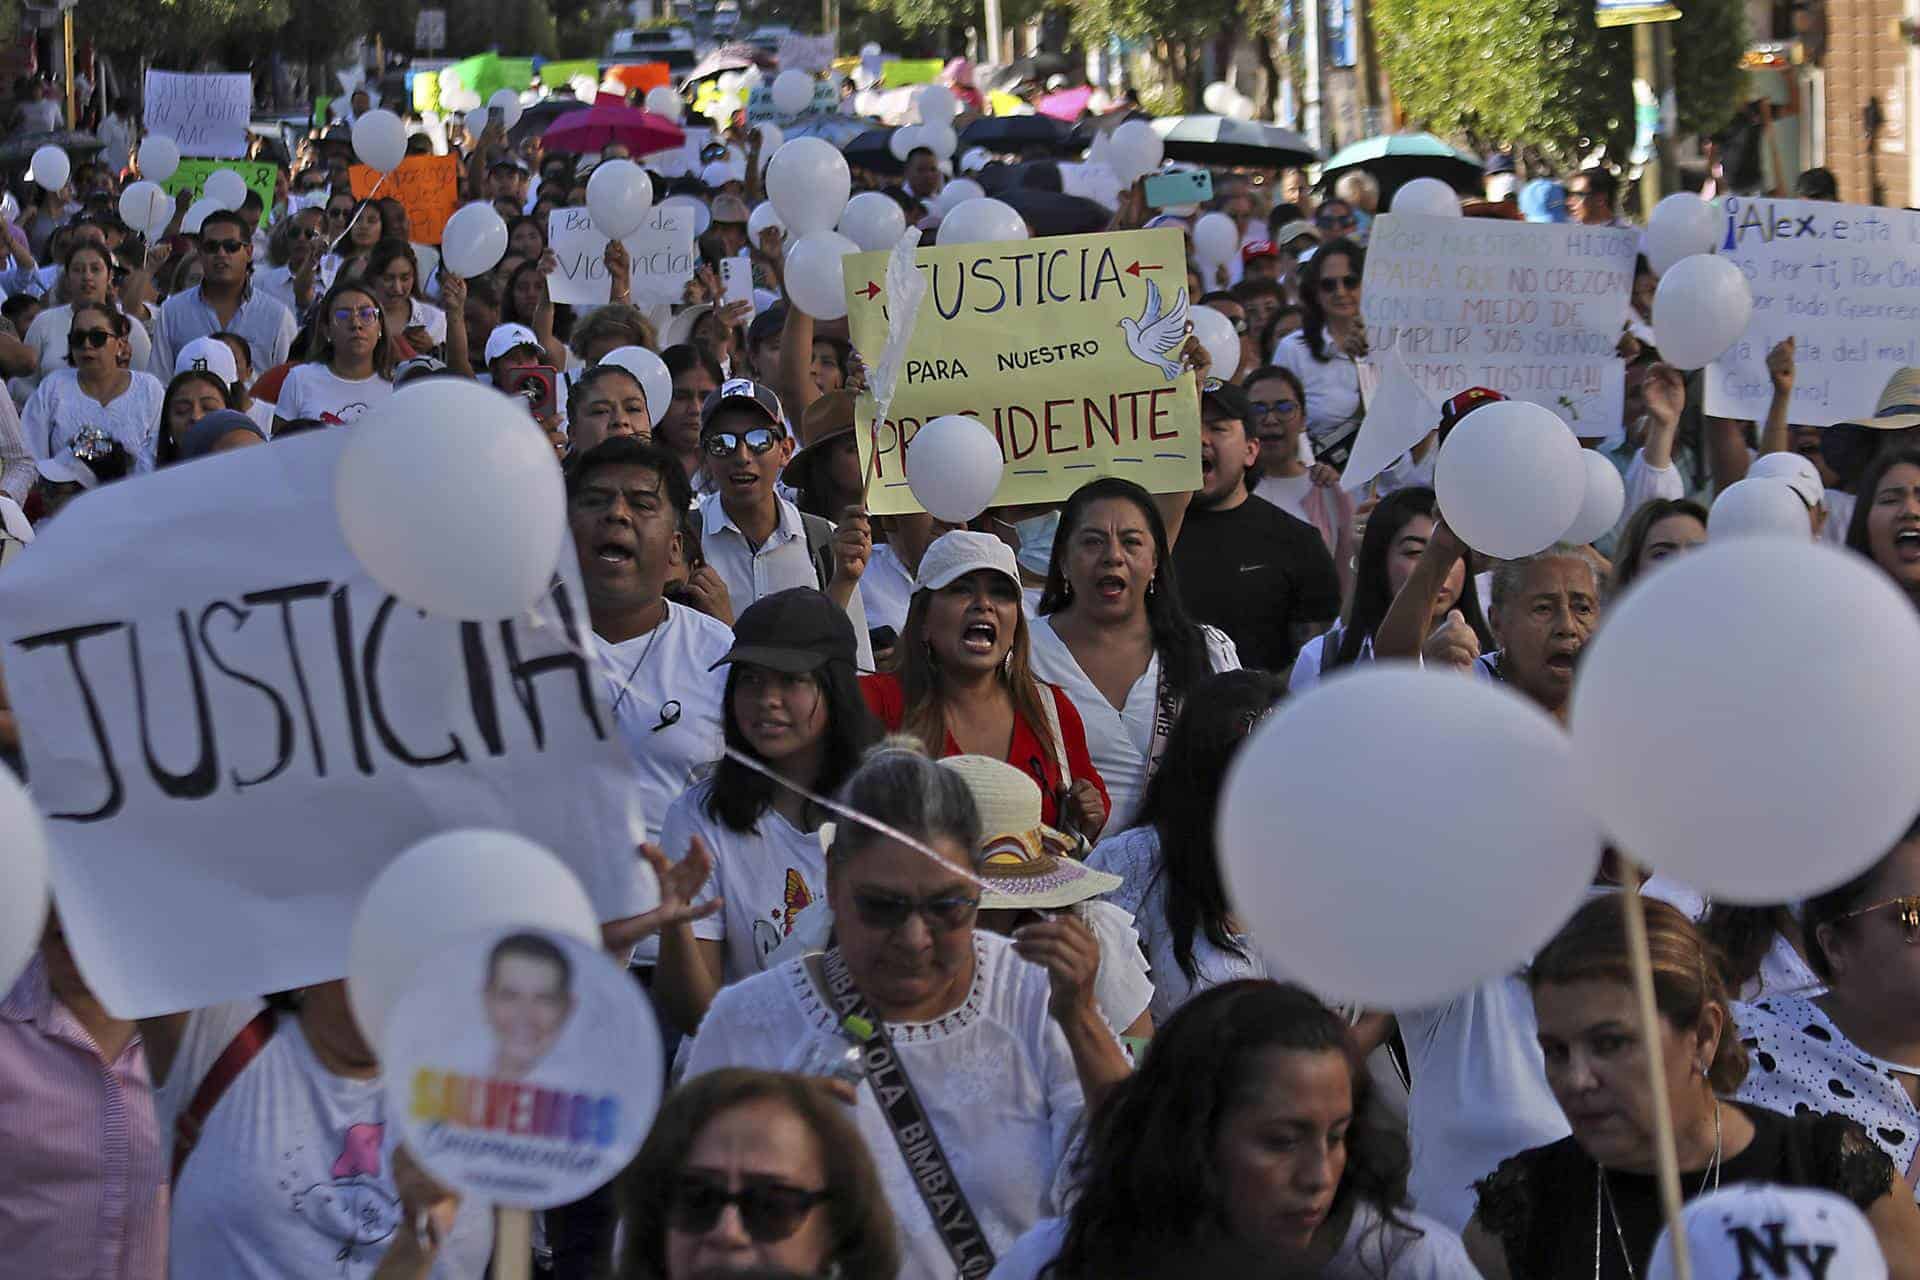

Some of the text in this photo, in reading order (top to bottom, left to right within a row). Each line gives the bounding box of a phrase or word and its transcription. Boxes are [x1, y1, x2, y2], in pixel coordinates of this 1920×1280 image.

[650, 208, 678, 236] de
[1567, 232, 1635, 258] HIJOS
[883, 246, 1127, 321] USTICIA
[1371, 260, 1441, 289] PARA
[1507, 267, 1539, 294] NO
[1462, 298, 1540, 325] MIEDO
[1550, 301, 1585, 327] DE
[1484, 327, 1524, 353] SUS
[906, 340, 1100, 384] PARA NUESTRO
[870, 386, 1179, 480] PRIDENTE
[1725, 1217, 1838, 1280] NY
